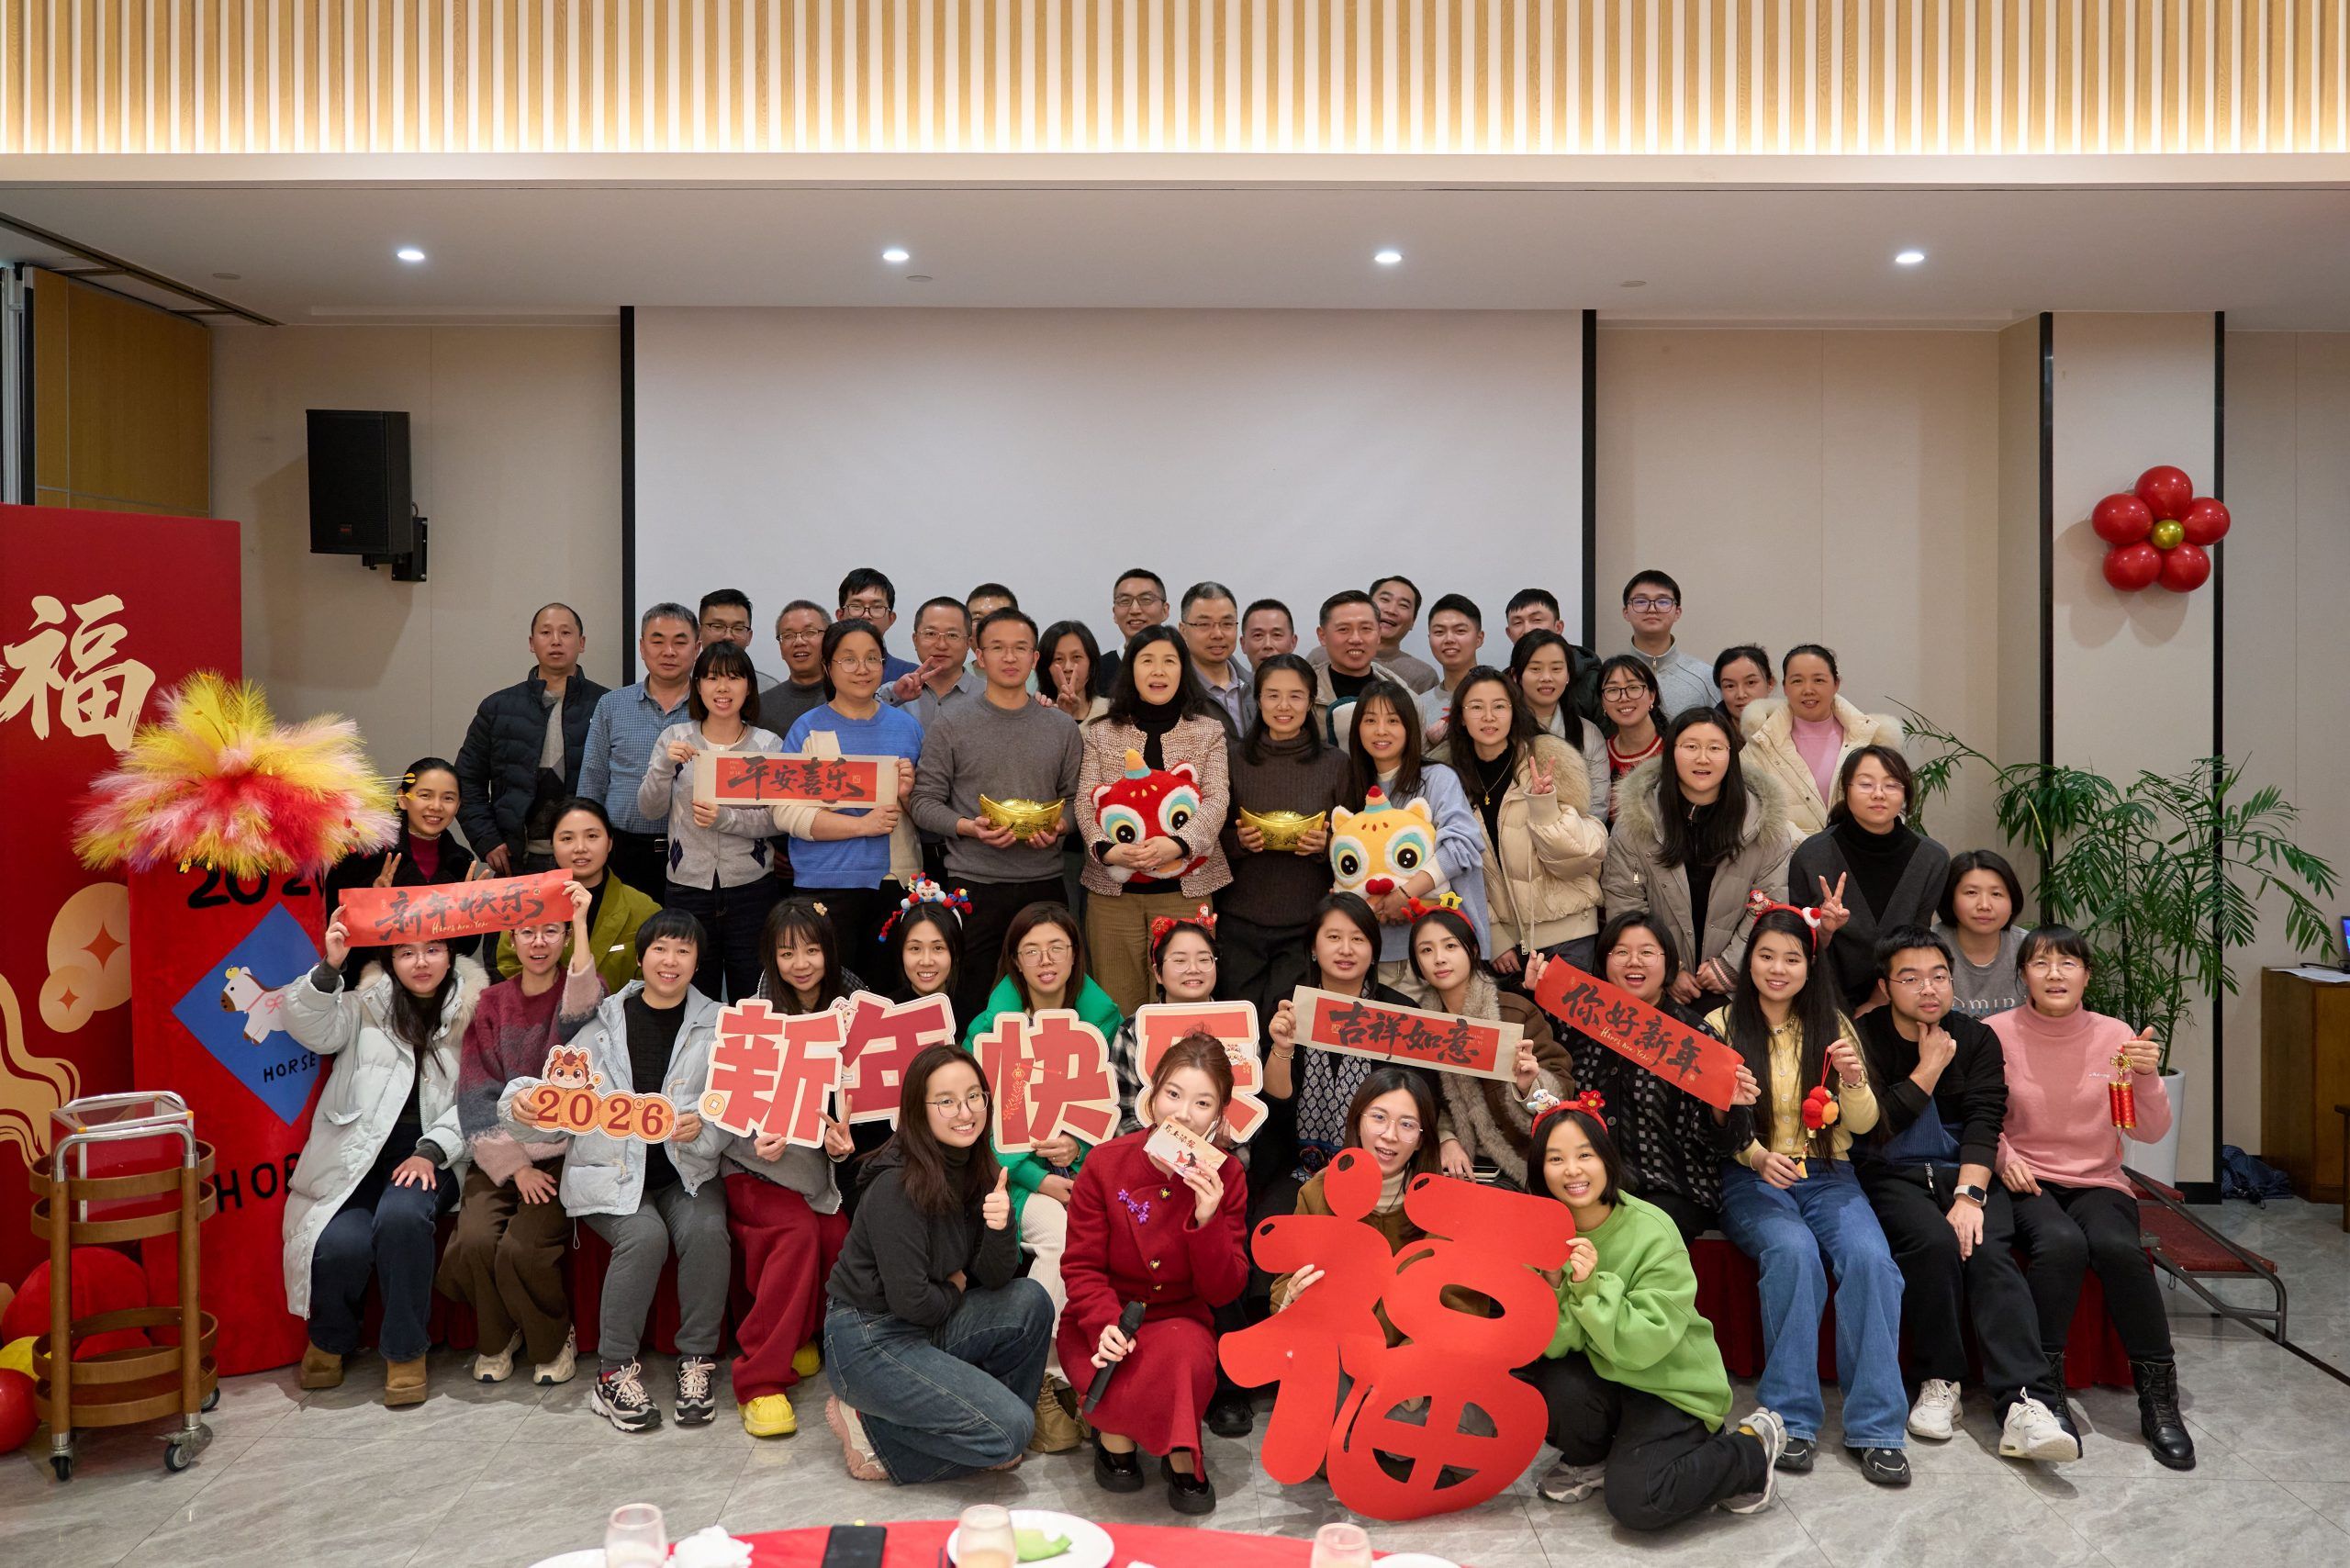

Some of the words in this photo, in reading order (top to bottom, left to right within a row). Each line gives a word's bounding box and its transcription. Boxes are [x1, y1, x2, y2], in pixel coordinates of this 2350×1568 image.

[0, 593, 156, 751] 福
[727, 755, 866, 805] 平安喜乐
[375, 881, 544, 943] 新年快乐
[263, 1052, 317, 1083] HORSE
[711, 1004, 841, 1142] 新
[839, 1001, 948, 1114] 年
[1328, 1000, 1480, 1065] 吉祥如意
[1561, 982, 1704, 1081] 你好新年
[538, 1090, 664, 1136] 2026
[981, 1018, 1112, 1145] 快
[1218, 1147, 1577, 1521] 福
